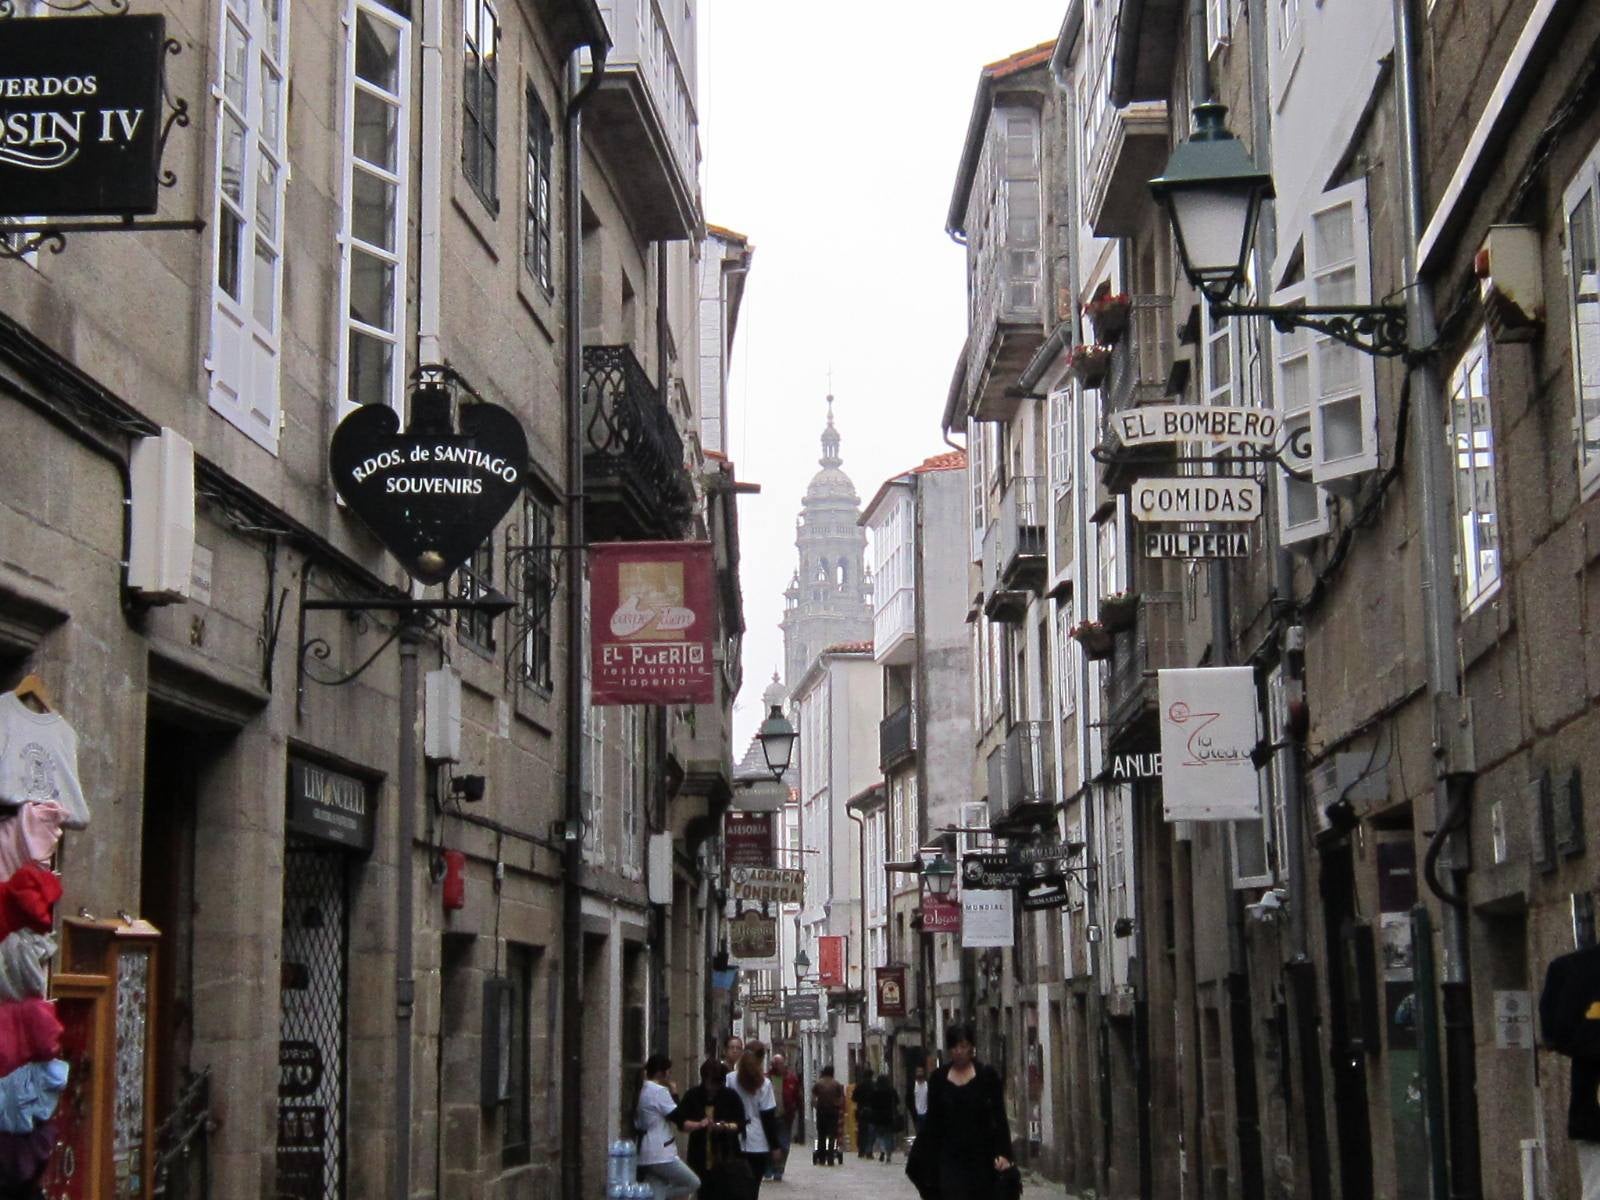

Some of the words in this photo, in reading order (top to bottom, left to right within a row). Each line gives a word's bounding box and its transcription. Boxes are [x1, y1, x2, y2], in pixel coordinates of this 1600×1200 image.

[0, 110, 86, 146] SIN
[98, 108, 144, 142] IV
[1122, 413, 1156, 440] EL
[1163, 411, 1276, 438] BOMBERO
[352, 449, 405, 484] RDOS.
[410, 445, 430, 462] de
[434, 445, 518, 484] SANTIAGO
[386, 476, 483, 495] SOUVENIRS
[1139, 487, 1254, 512] COMIDAS
[1146, 533, 1249, 557] PULPERIA
[603, 647, 623, 666] EL
[603, 665, 705, 676] restaurante
